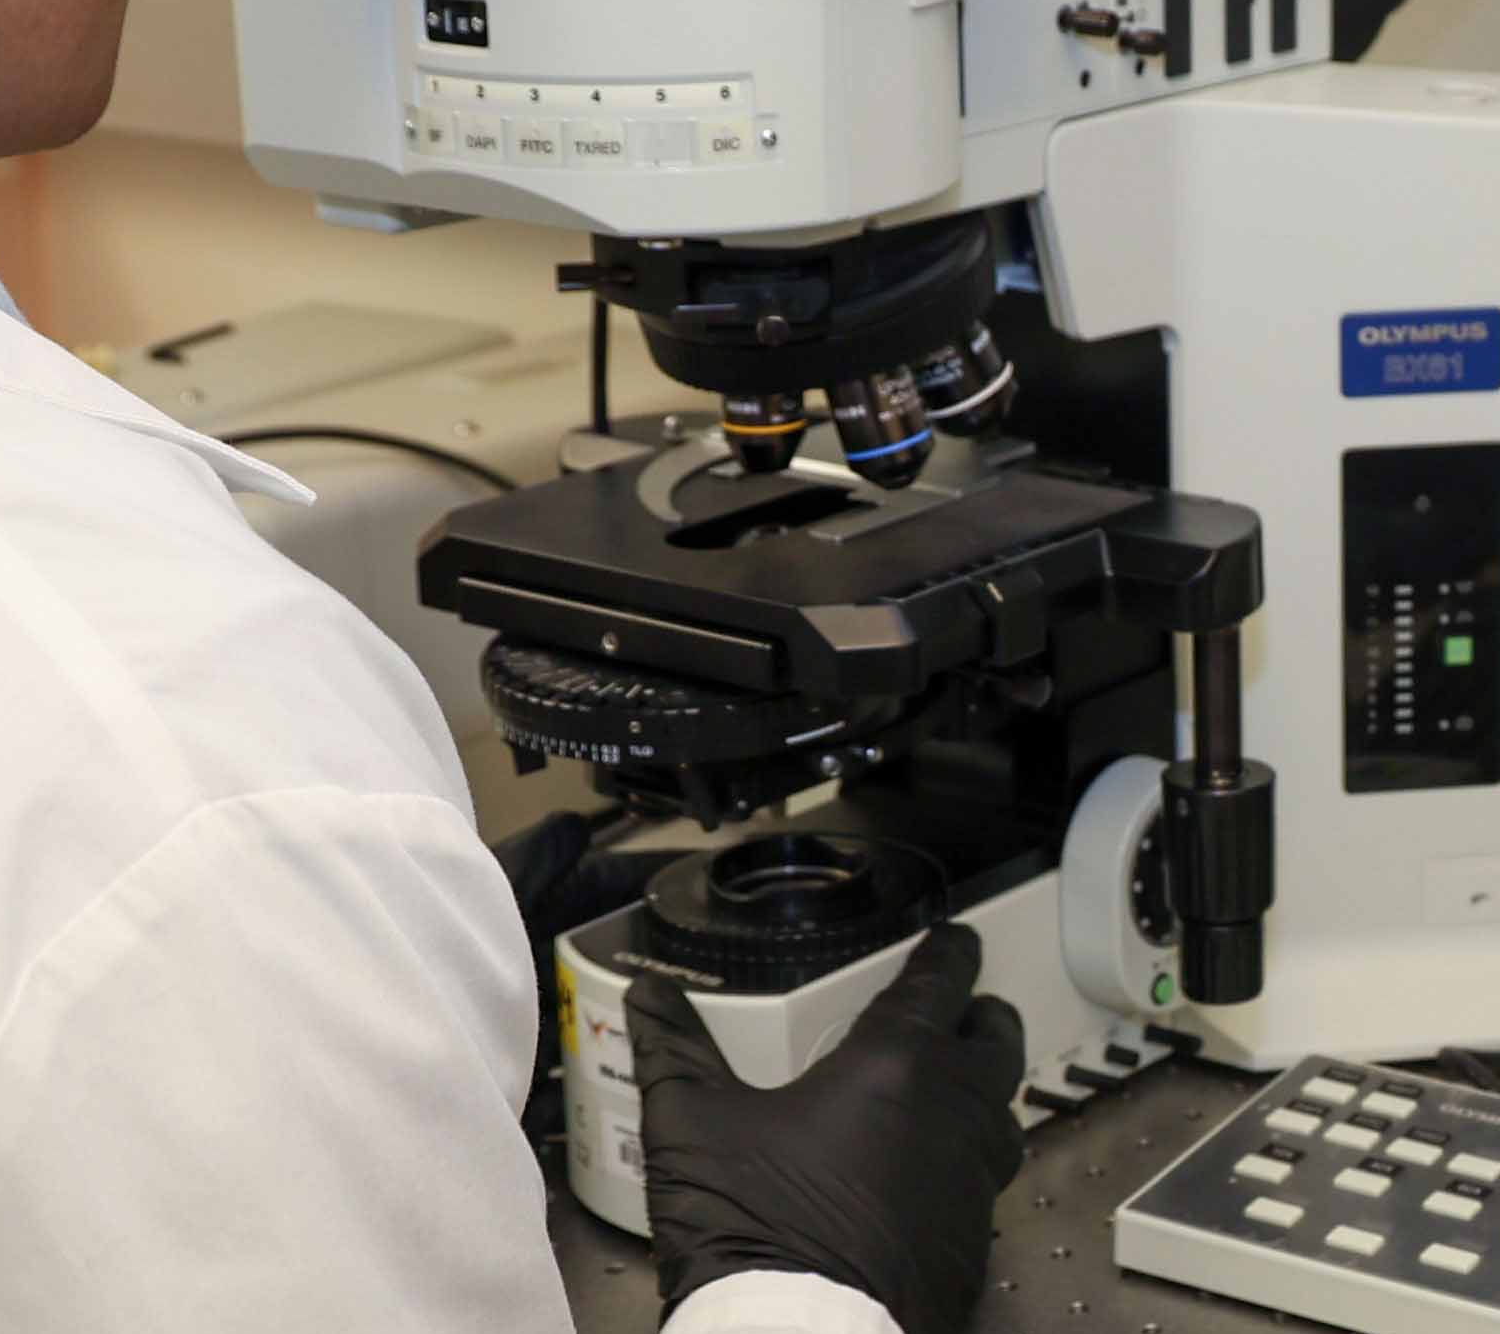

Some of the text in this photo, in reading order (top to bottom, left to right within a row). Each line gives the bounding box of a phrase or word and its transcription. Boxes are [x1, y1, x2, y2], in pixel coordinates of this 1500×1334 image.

[475, 83, 732, 104] 2 3 4 5 6
[519, 136, 741, 156] FITC TXRED DIC
[1356, 319, 1490, 348] OLYMPUS
